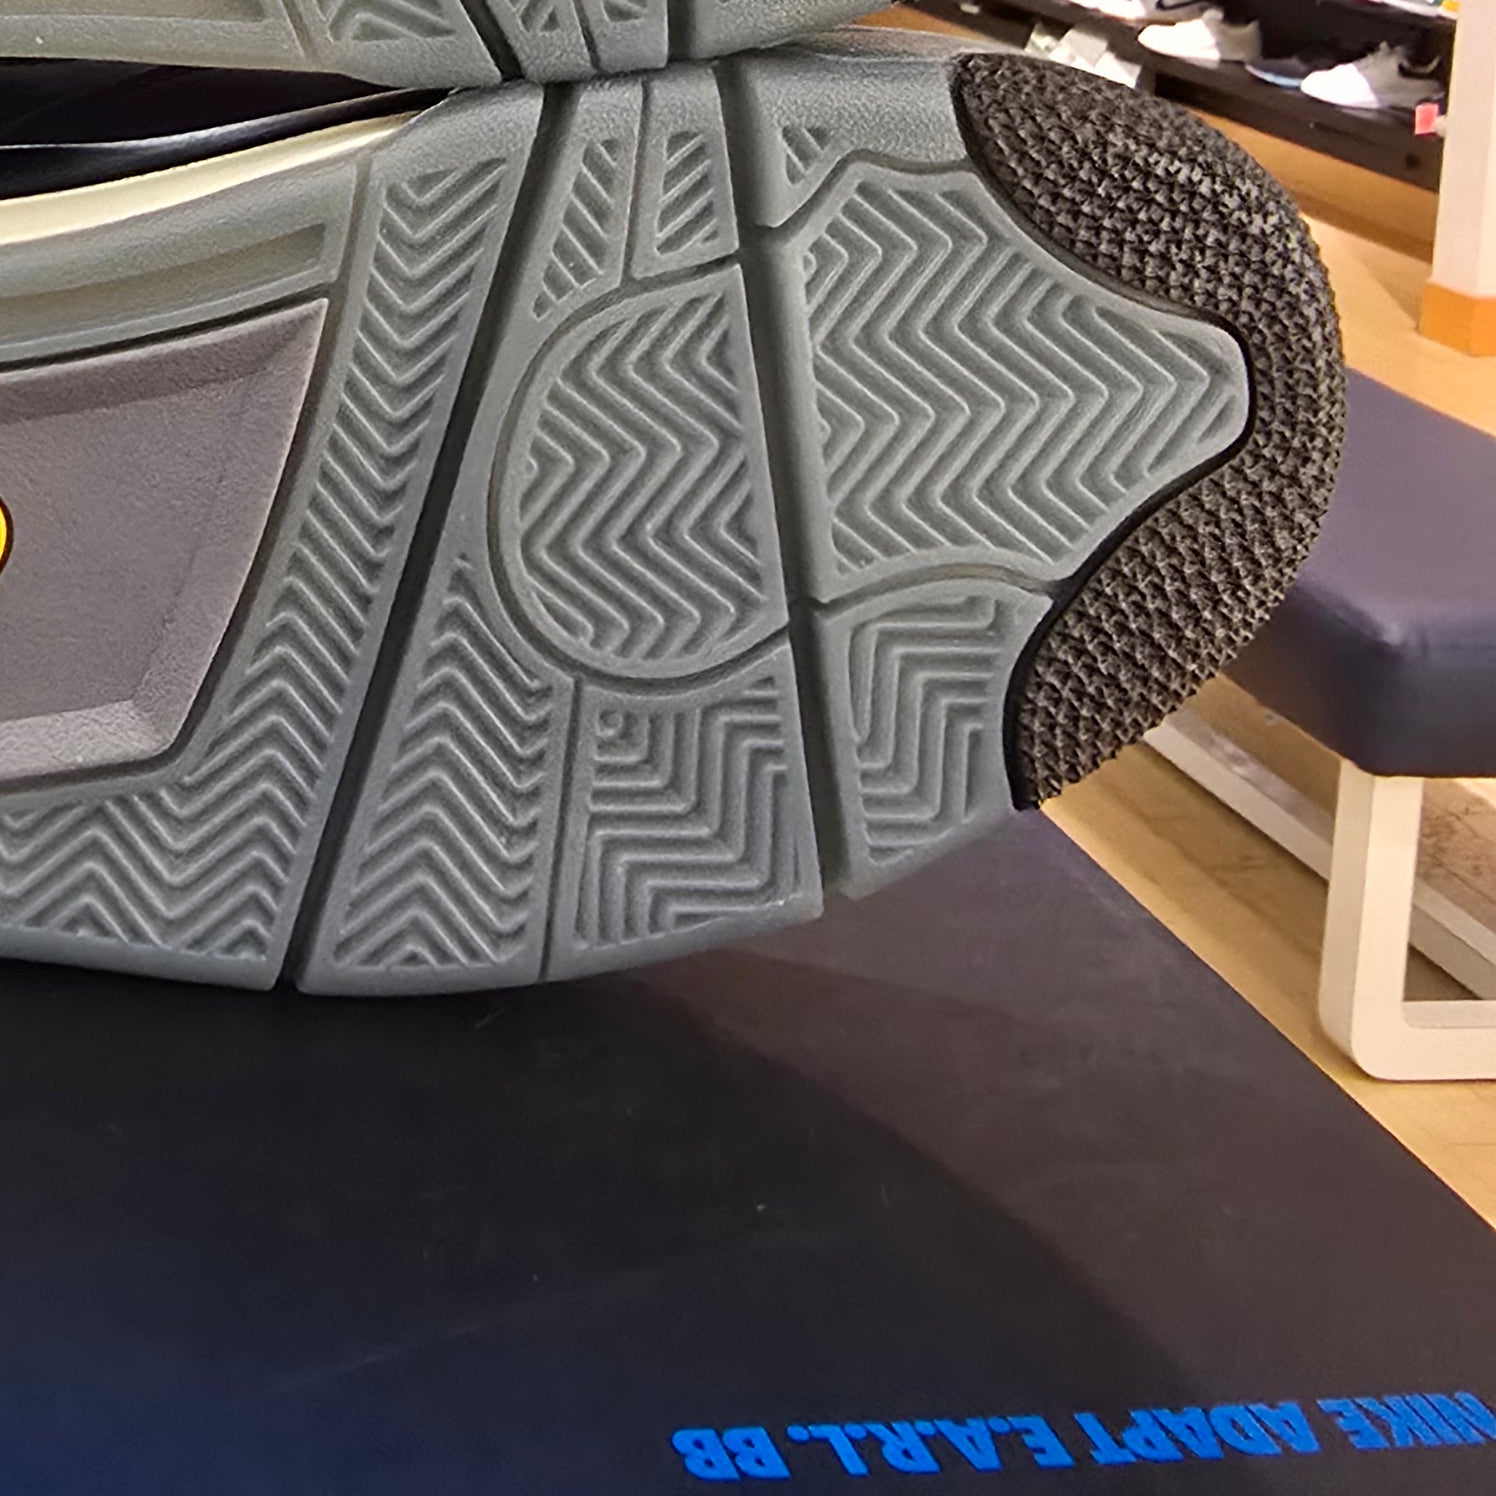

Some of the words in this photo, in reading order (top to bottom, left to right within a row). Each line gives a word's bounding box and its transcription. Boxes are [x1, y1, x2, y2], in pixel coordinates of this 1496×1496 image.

[1073, 1402, 1322, 1464] ADAPT
[1316, 1391, 1496, 1449] NIKE
[671, 1425, 791, 1481] BB
